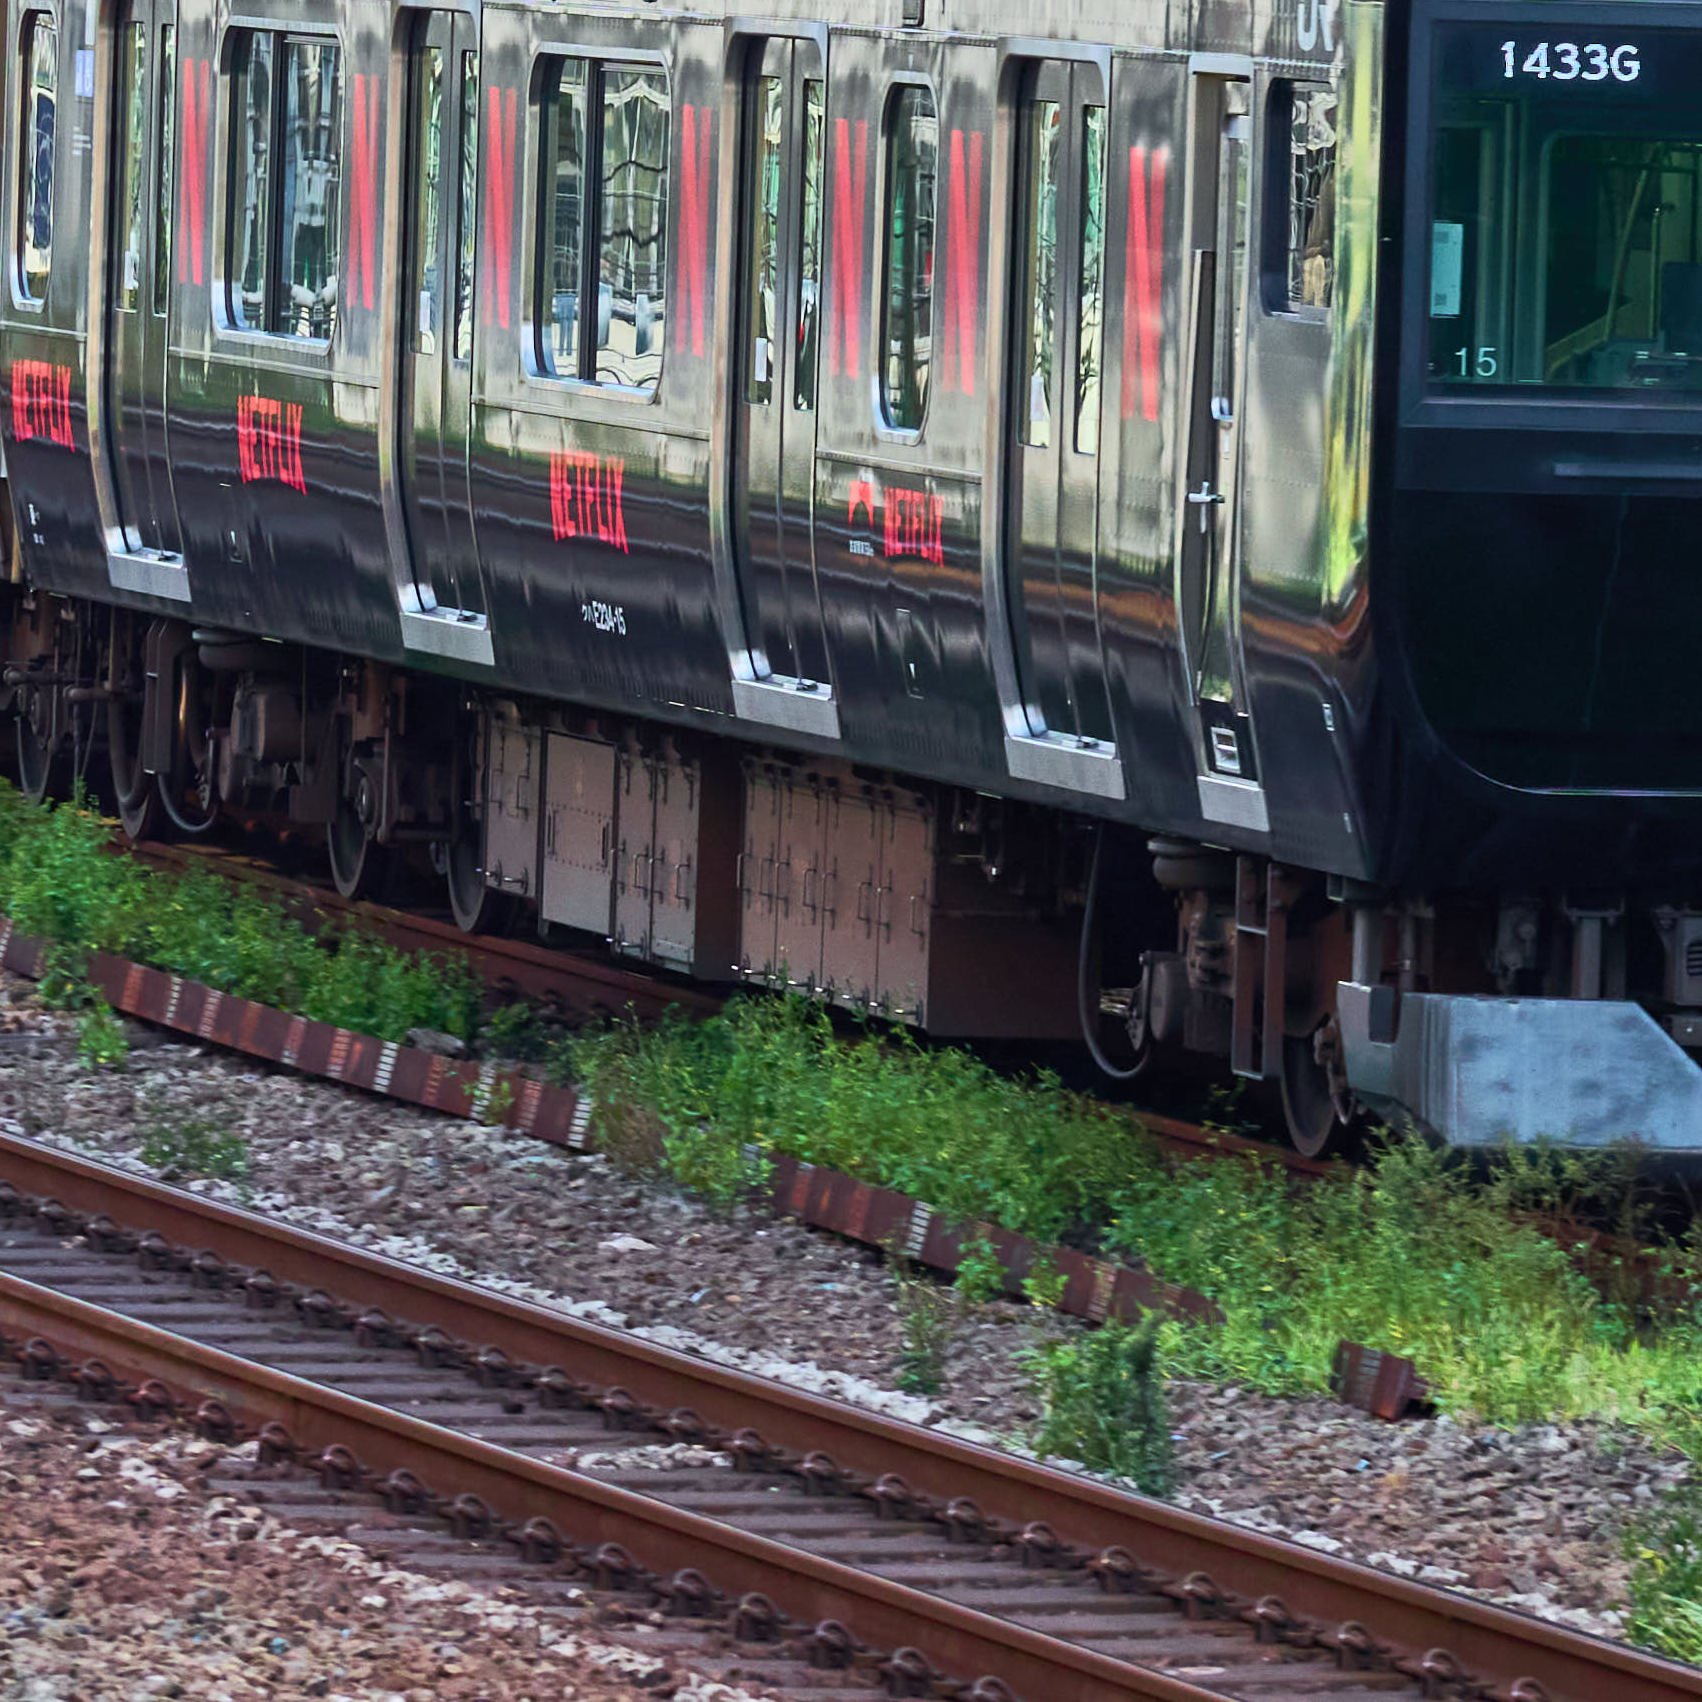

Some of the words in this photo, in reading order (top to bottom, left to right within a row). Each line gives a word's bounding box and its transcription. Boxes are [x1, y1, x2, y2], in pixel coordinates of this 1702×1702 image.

[1501, 41, 1641, 82] 1433G
[12, 359, 76, 453] NETFLIX
[1455, 348, 1498, 377] 15
[237, 395, 307, 496] NETFLIX
[549, 447, 629, 555] NETFLIX
[883, 486, 945, 568] NETFLIX
